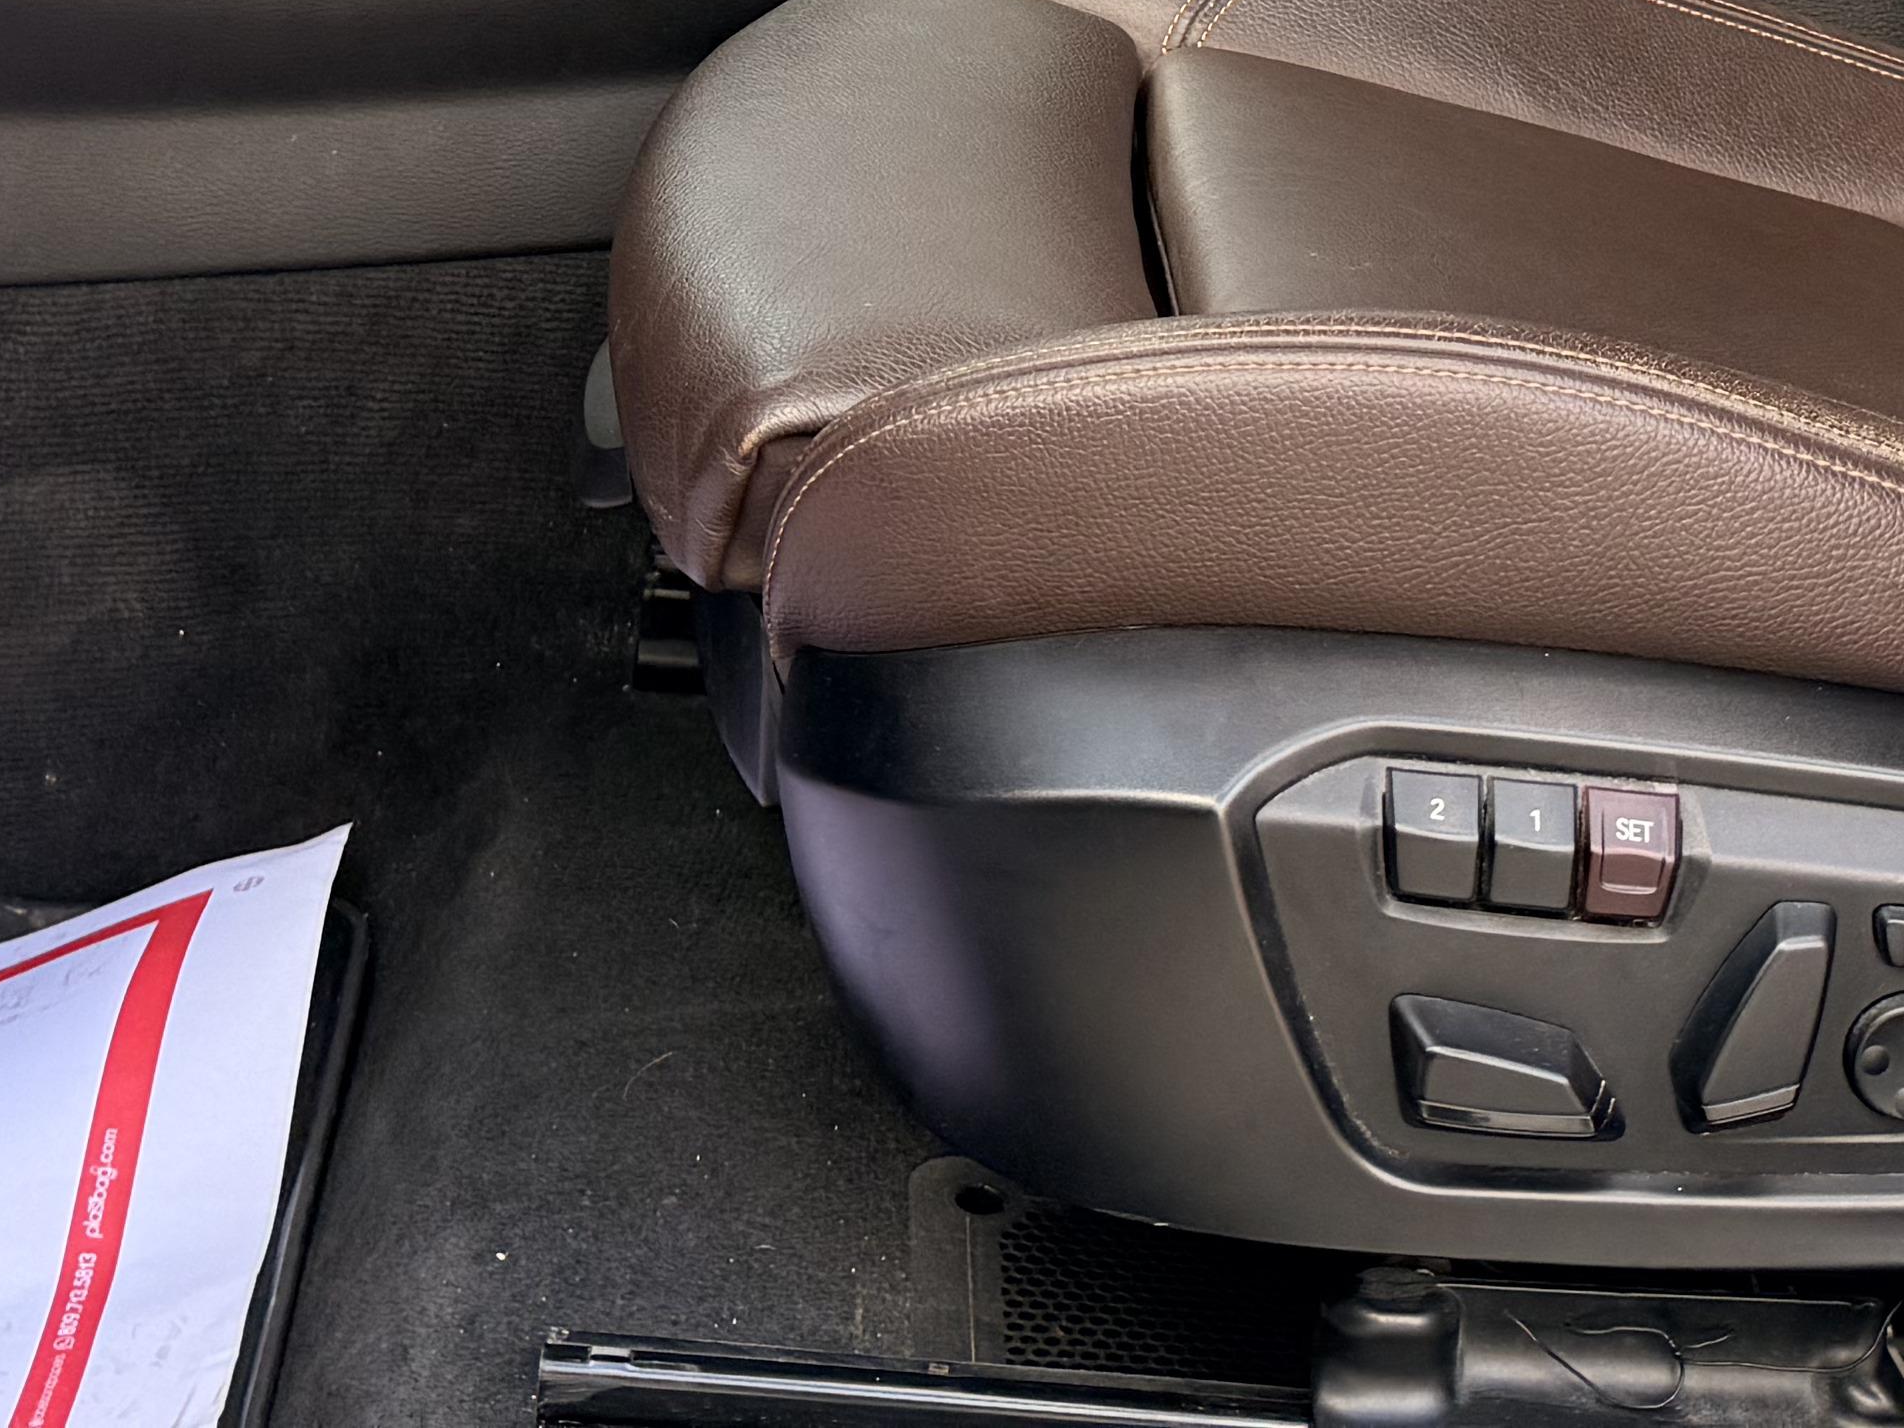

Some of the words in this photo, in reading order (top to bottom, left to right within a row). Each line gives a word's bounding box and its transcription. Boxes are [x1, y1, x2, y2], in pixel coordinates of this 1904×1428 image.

[1429, 798, 1446, 821] 2
[1529, 808, 1541, 832] 1
[1613, 817, 1654, 844] SET
